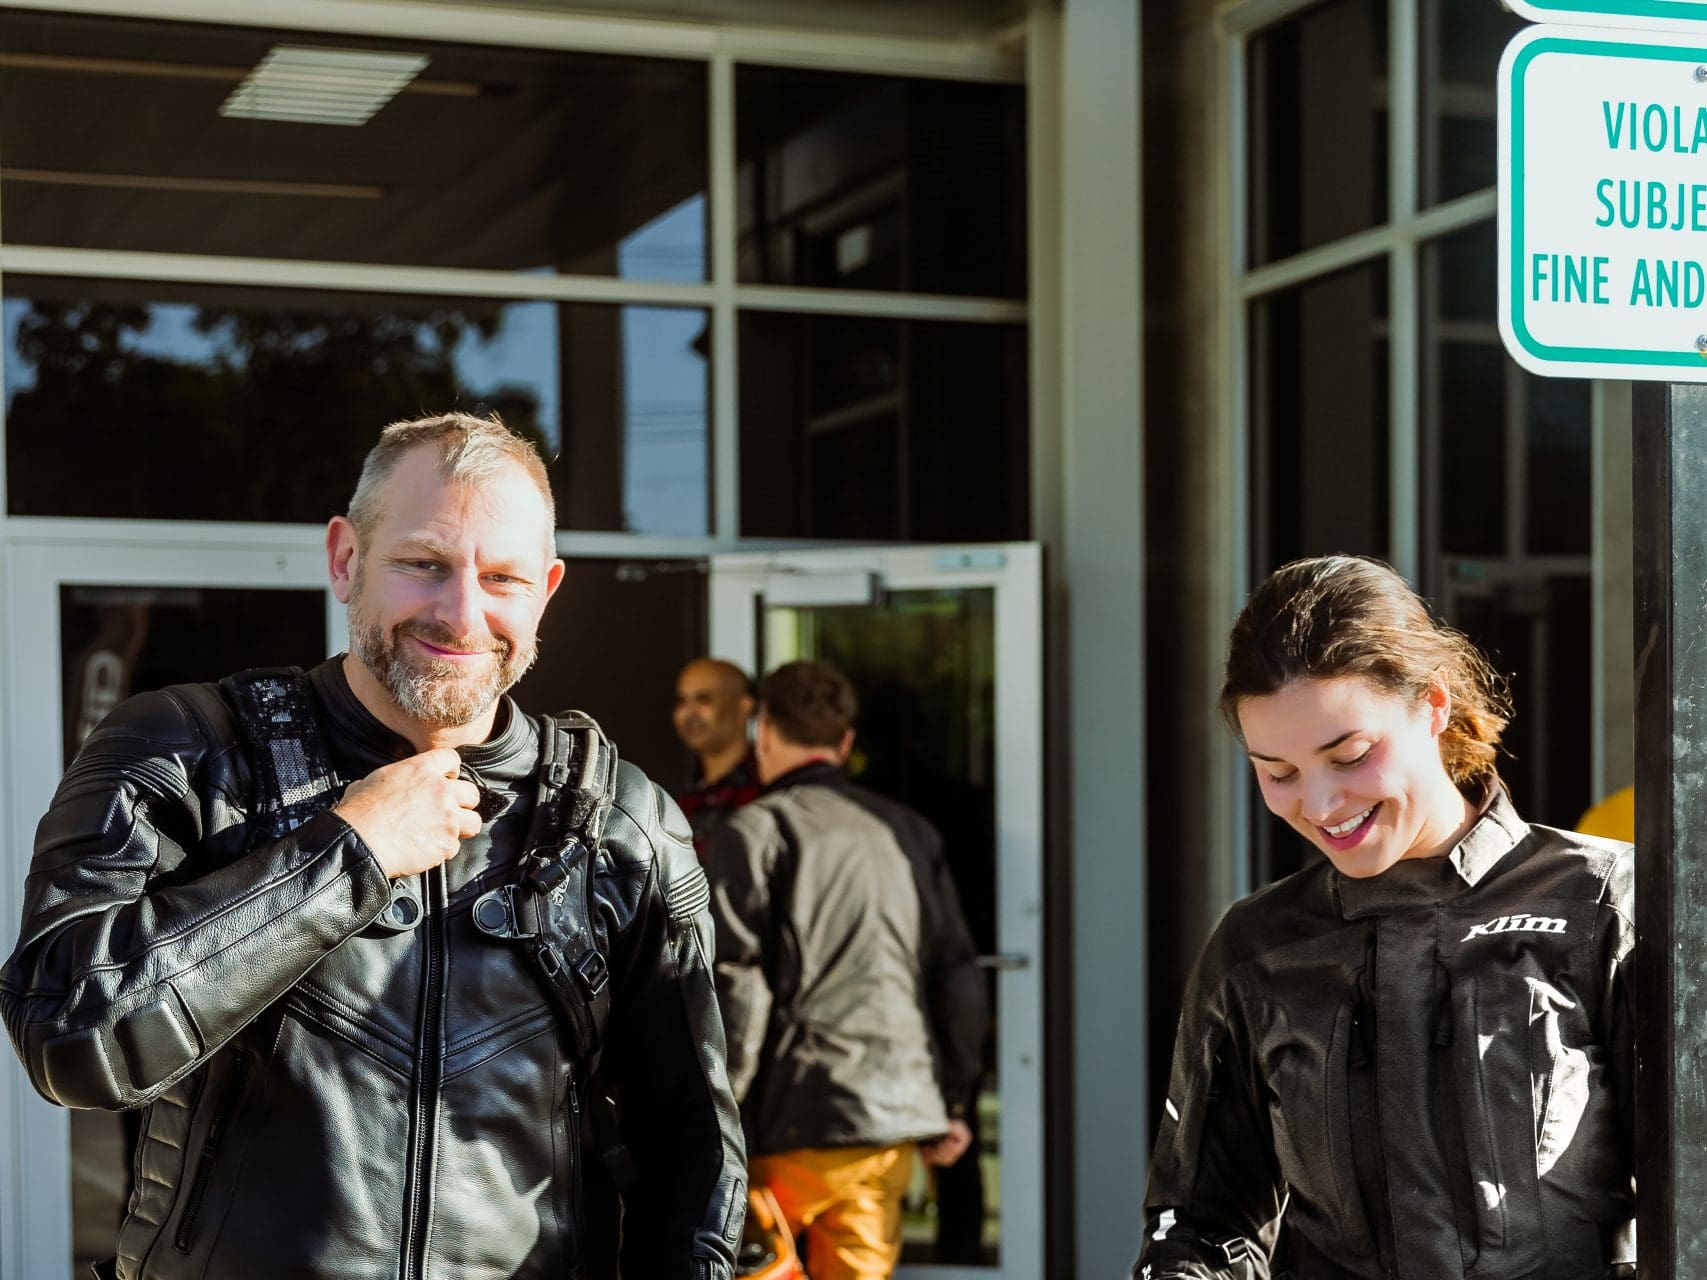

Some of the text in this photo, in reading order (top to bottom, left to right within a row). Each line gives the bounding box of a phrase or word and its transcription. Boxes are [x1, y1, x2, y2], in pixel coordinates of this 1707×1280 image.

[1602, 101, 1707, 154] VIOLA
[1595, 178, 1707, 231] SUBJE
[1532, 253, 1705, 308] FINE AND
